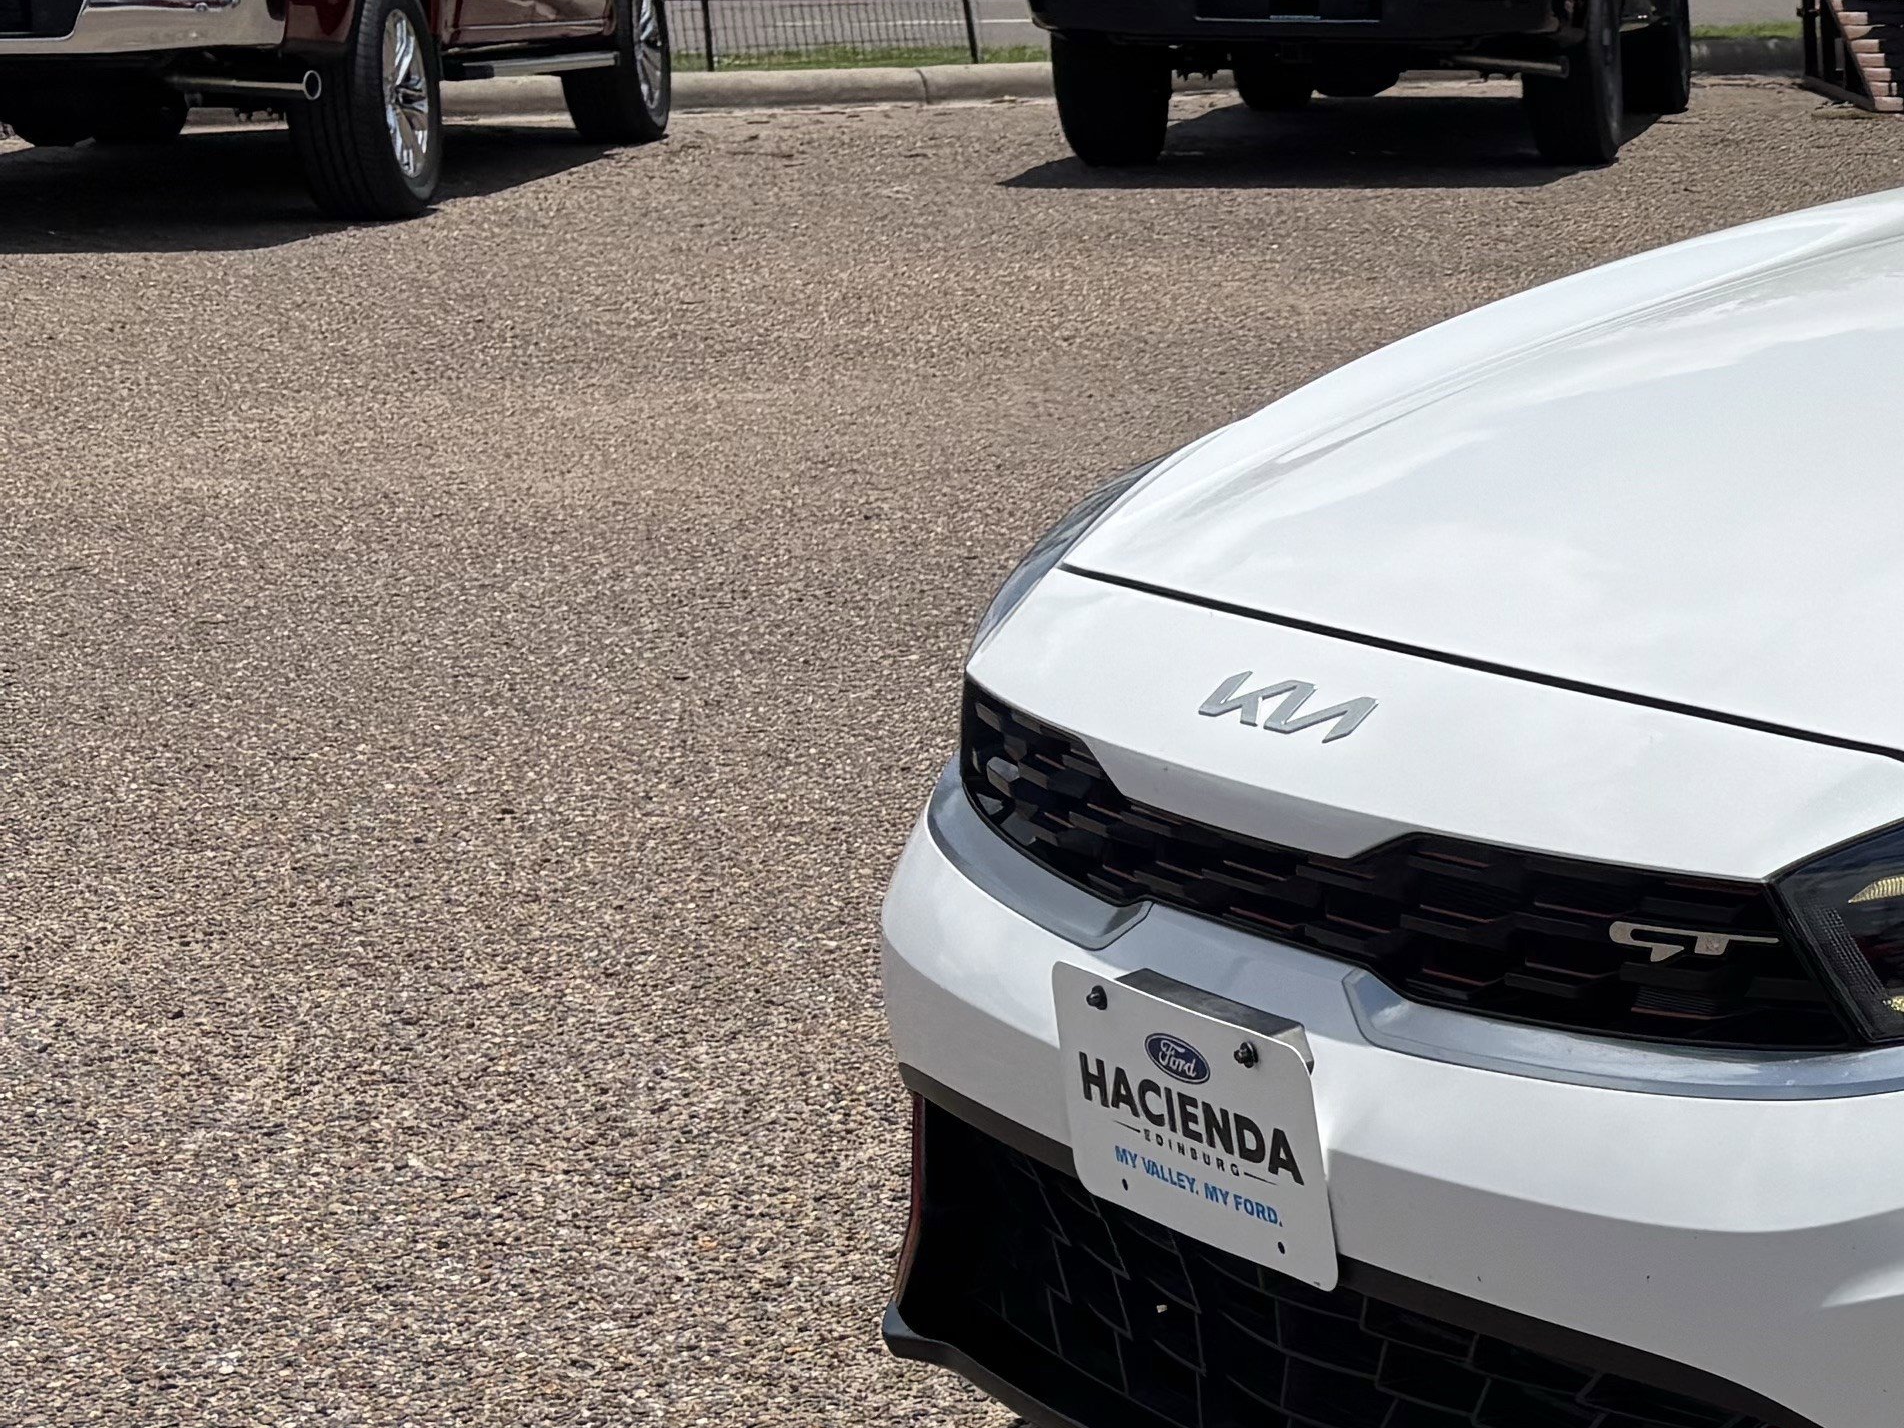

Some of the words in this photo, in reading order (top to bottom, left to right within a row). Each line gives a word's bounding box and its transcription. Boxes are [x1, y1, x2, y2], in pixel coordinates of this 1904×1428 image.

[1197, 670, 1380, 744] KIA
[1608, 920, 1780, 963] GT
[1156, 1037, 1198, 1079] Ford
[1078, 1051, 1304, 1186] HACIENDA
[1143, 1128, 1240, 1177] EDINBURG
[1114, 1145, 1138, 1169] MY
[1140, 1156, 1199, 1195] VALLEY.
[1204, 1182, 1229, 1206] MY
[1234, 1194, 1283, 1228] FORD.
